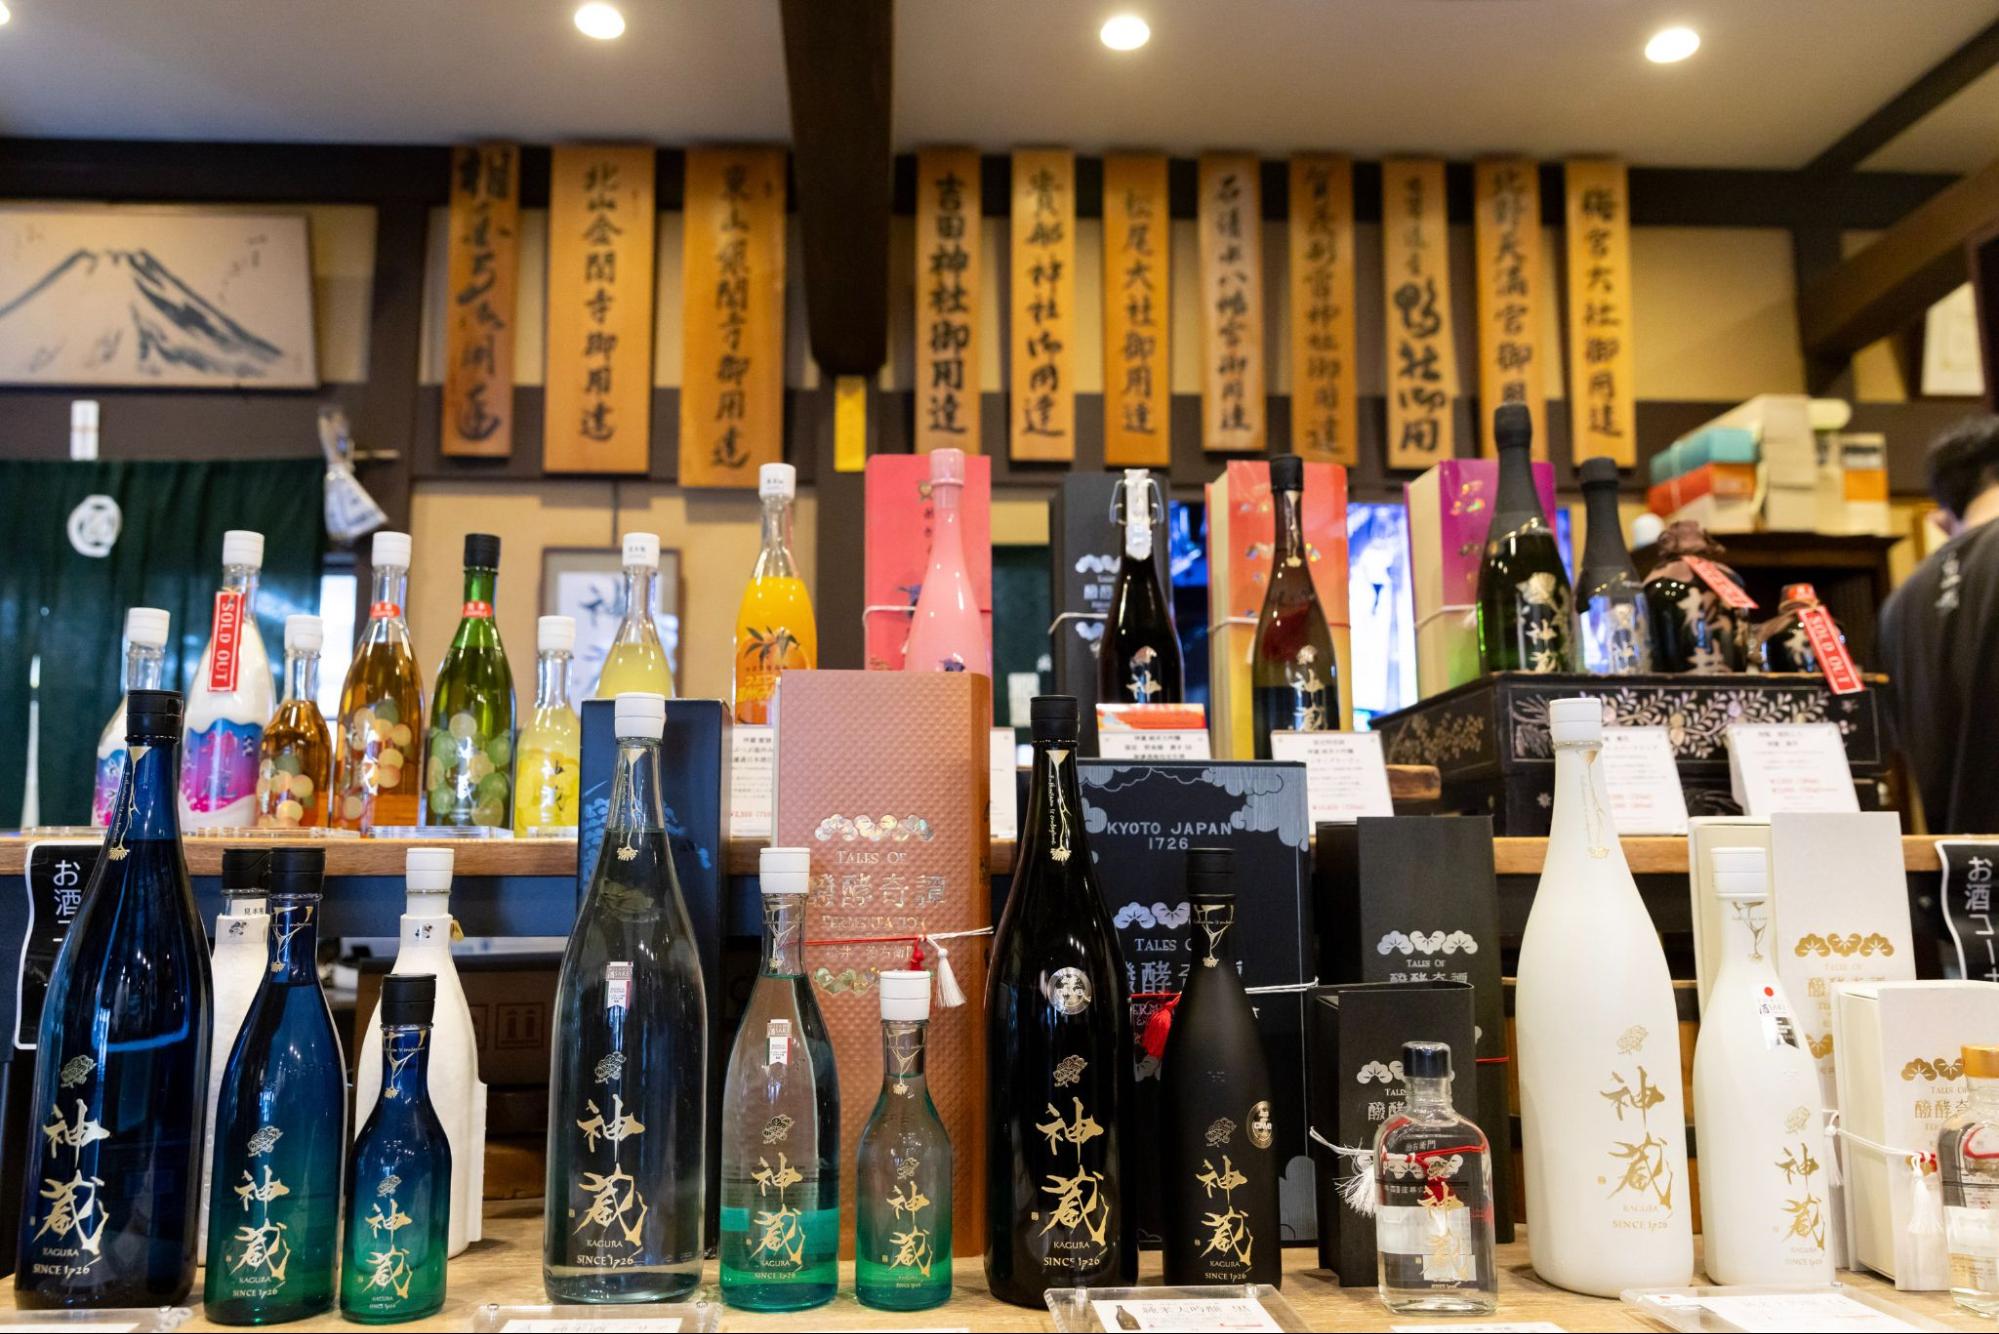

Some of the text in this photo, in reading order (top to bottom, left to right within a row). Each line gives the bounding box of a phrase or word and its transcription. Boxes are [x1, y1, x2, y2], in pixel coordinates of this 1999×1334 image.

[928, 171, 971, 434] 吉田神社御用達
[213, 602, 235, 682] SOLD OUT
[1810, 614, 1850, 684] SOLD OUT
[1107, 822, 1232, 836] KYOTO JAPAN
[1149, 837, 1189, 850] 1726
[1135, 938, 1177, 952] TALES
[33, 1098, 110, 1256] 神蔵
[572, 1093, 647, 1247] 神蔵
[1035, 1096, 1110, 1248] 神蔵
[1600, 1065, 1673, 1210] 神蔵
[229, 1164, 291, 1281] 神蔵
[750, 1151, 806, 1266] 神蔵
[886, 1181, 933, 1278] 神蔵
[1196, 1155, 1254, 1267] 神蔵
[1775, 1142, 1825, 1250] 神蔵
[362, 1198, 414, 1300] 神蔵
[576, 1254, 635, 1270] SINCE 1726
[586, 1239, 624, 1248] KAGURA
[1043, 1256, 1100, 1271] SINCE 1726
[1053, 1241, 1090, 1249] KAGURA
[1204, 1272, 1229, 1280] SINCE
[1209, 1260, 1241, 1268] KAGURA
